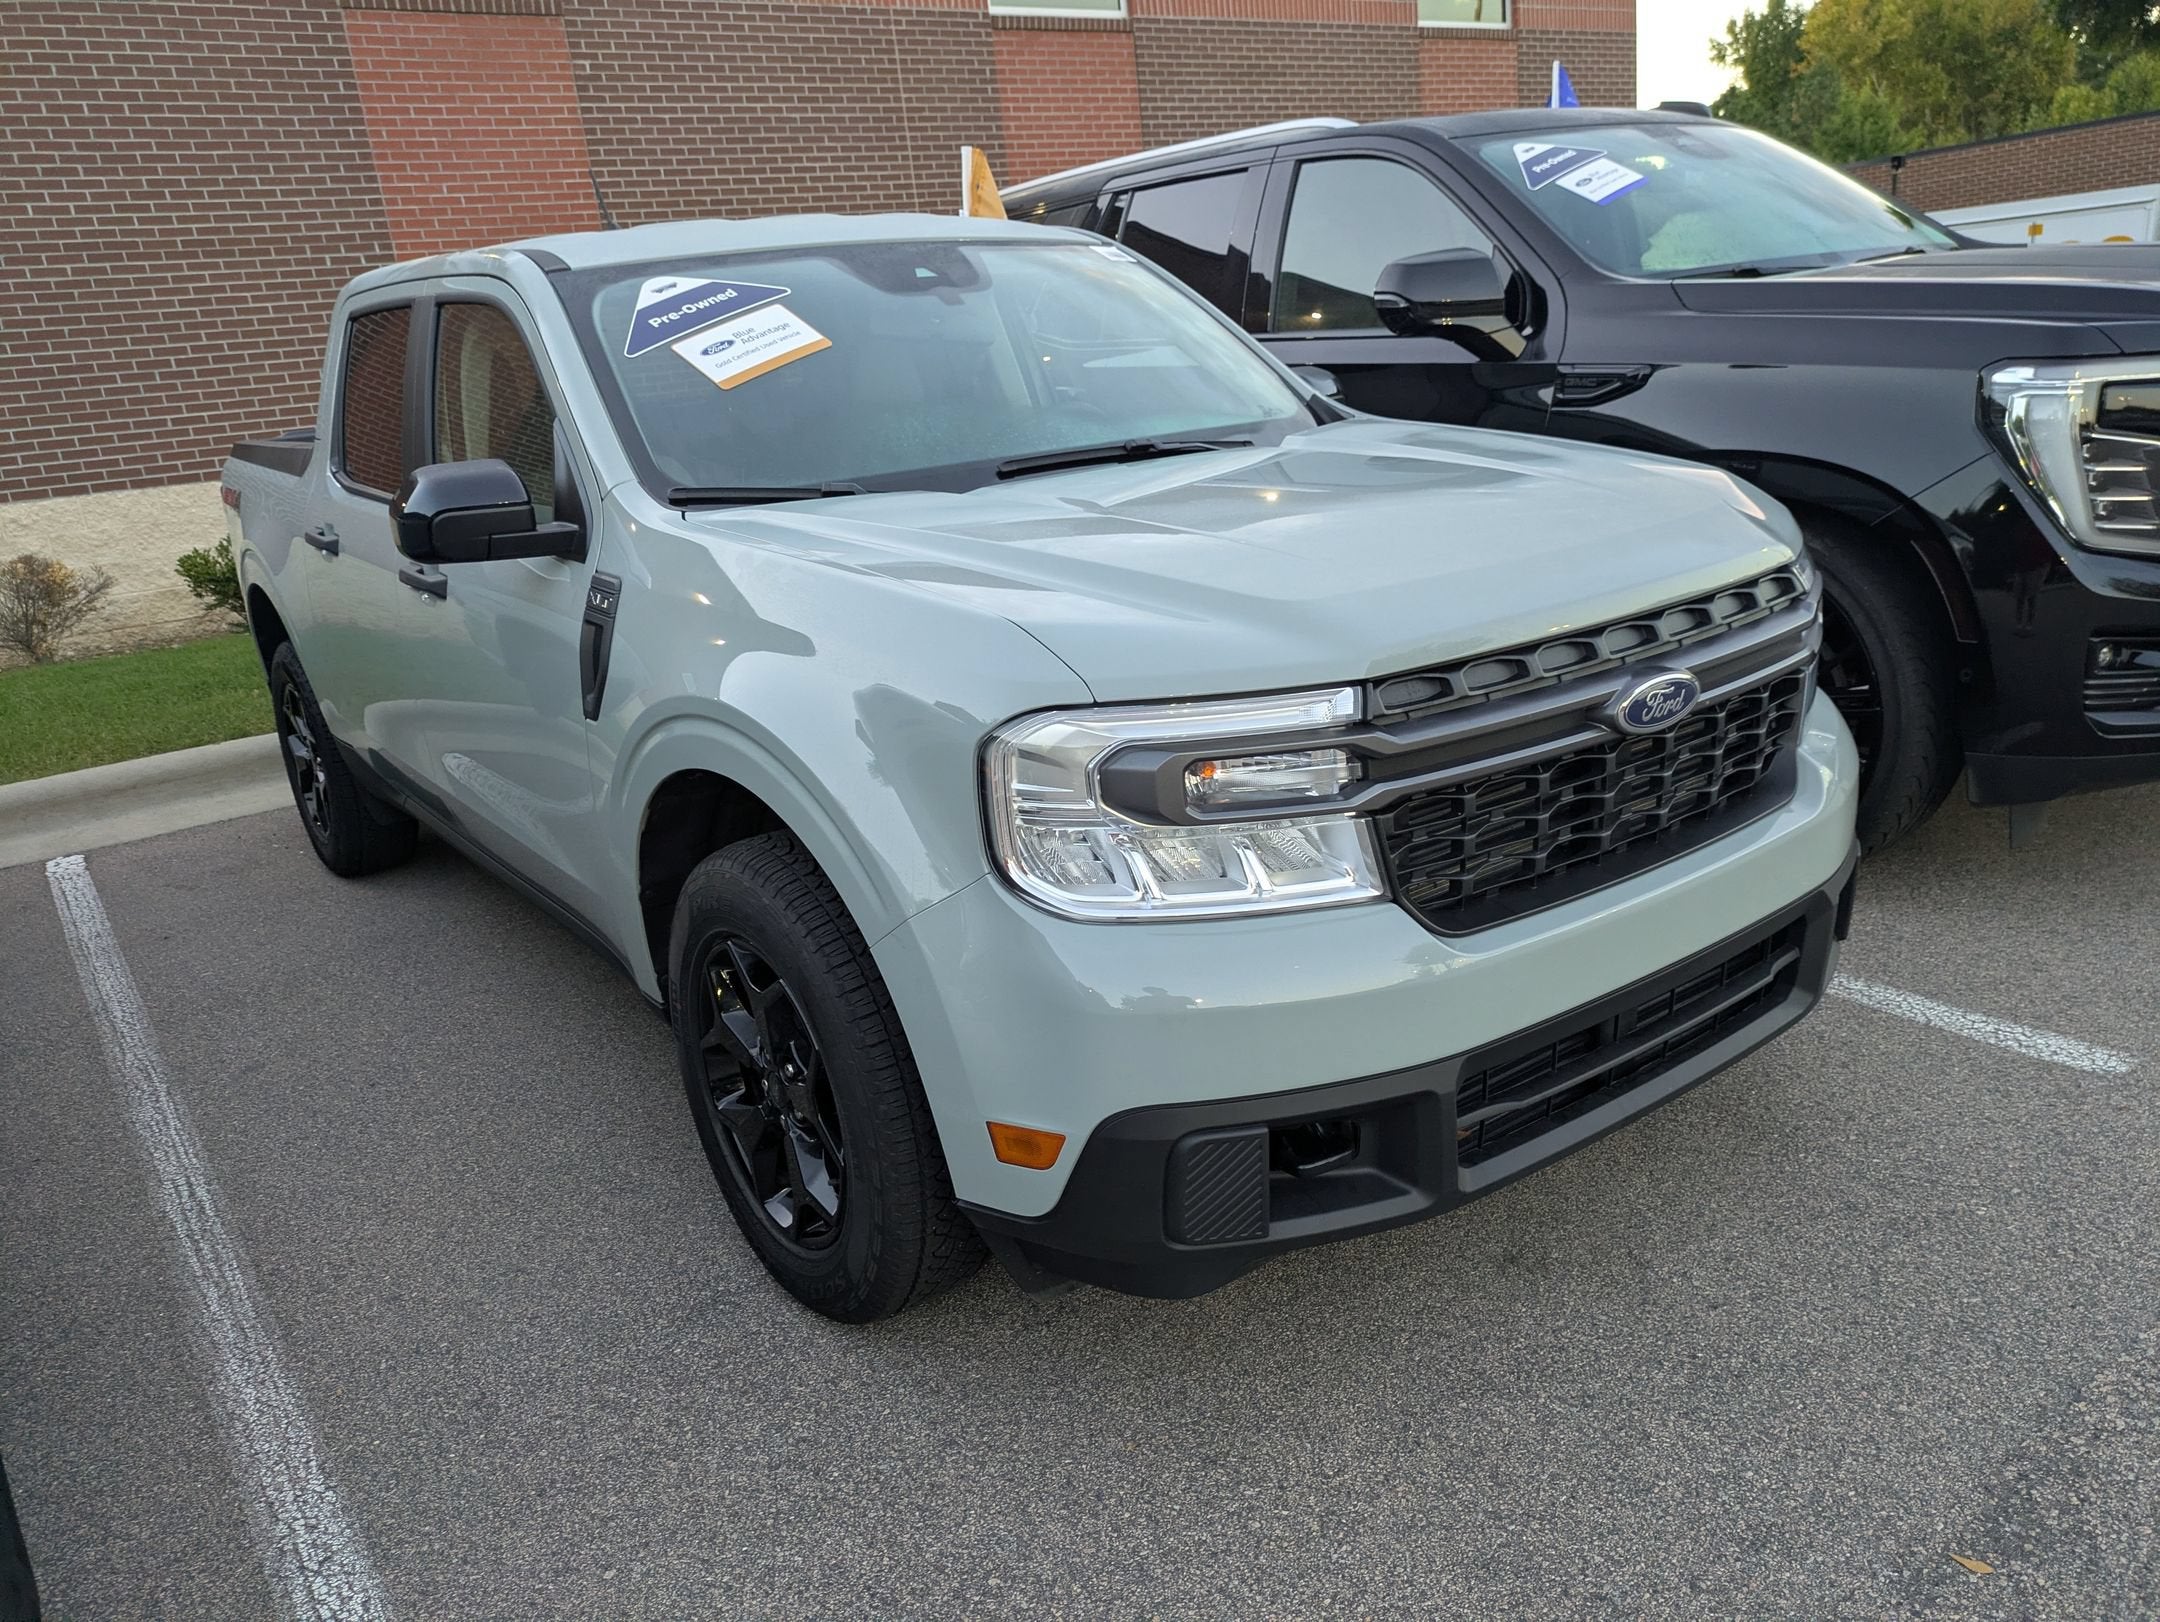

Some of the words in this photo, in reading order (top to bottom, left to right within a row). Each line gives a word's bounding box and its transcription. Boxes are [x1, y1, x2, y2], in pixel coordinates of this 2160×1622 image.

[648, 288, 738, 328] Pre-Owned
[732, 327, 756, 339] Blue
[740, 322, 791, 345] Advantage
[715, 357, 733, 369] Gold
[1641, 686, 1685, 722] Ford
